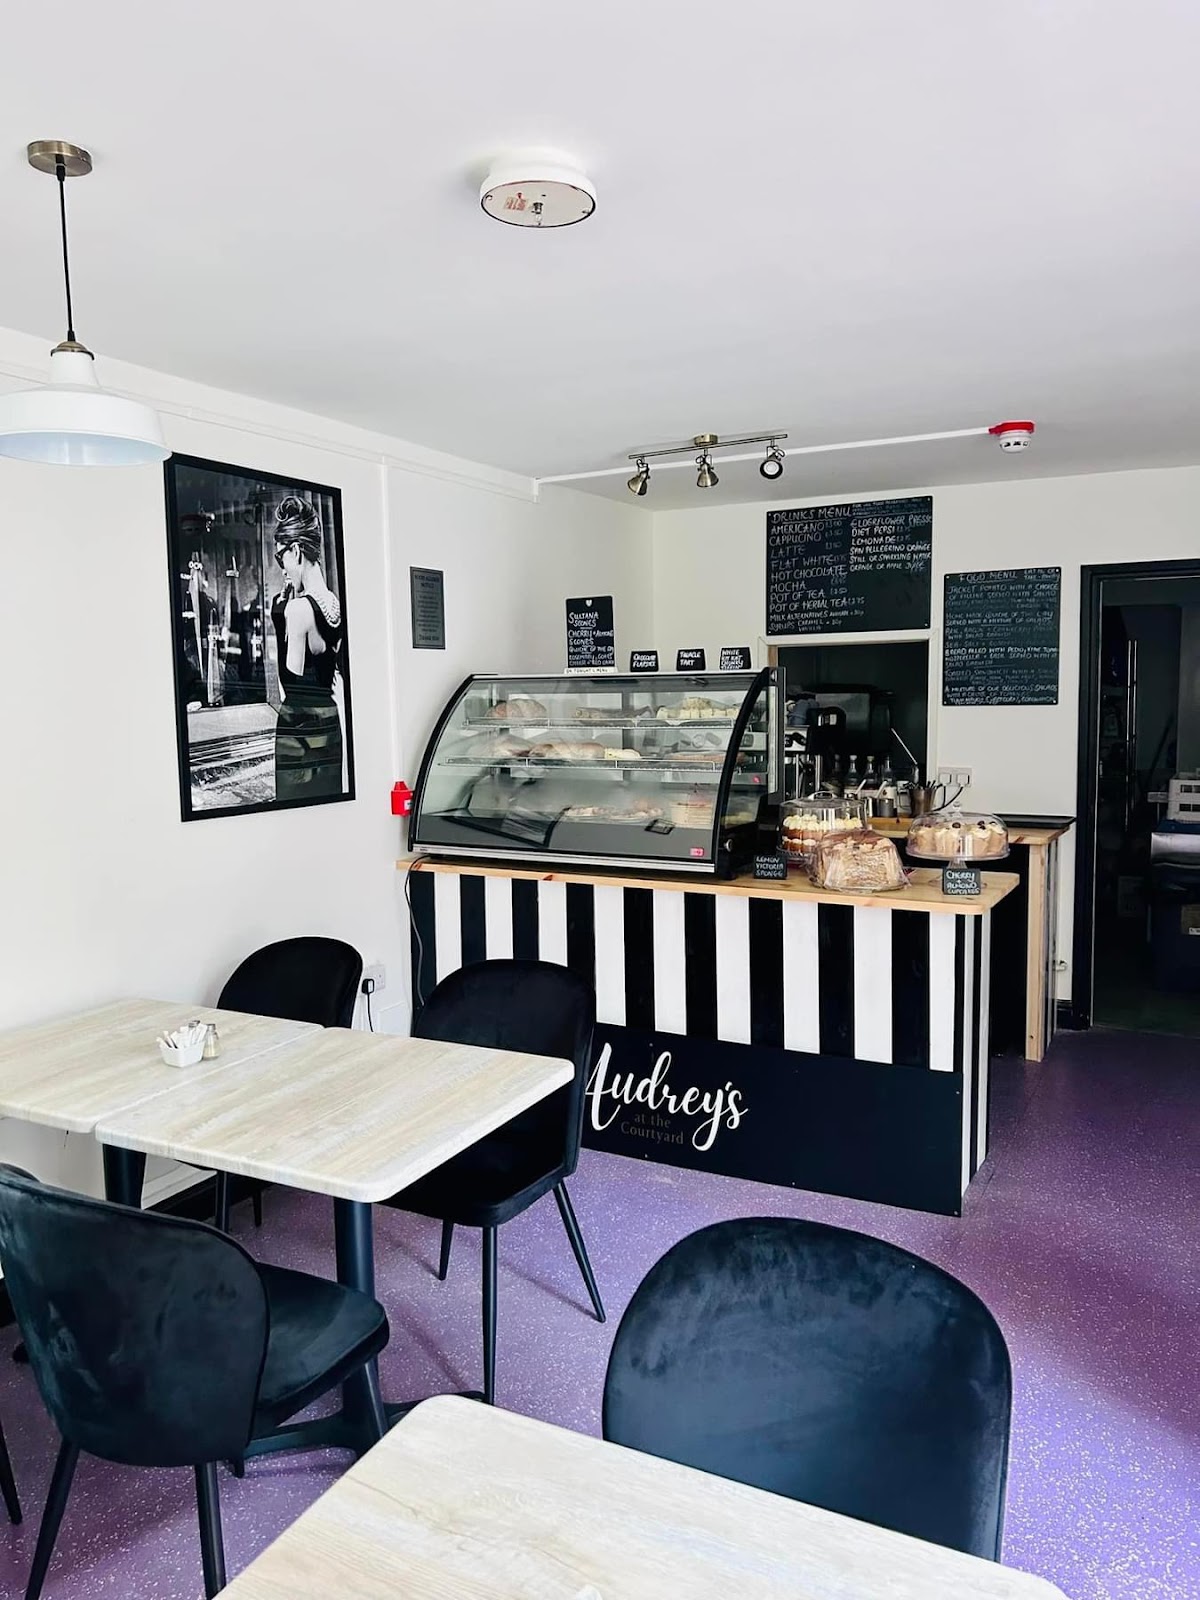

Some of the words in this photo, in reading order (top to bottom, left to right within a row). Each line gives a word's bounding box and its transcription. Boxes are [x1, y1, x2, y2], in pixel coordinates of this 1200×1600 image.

[771, 509, 815, 524] DRINKS
[818, 506, 852, 519] MENU
[771, 522, 825, 535] AMERICANO
[850, 515, 905, 529] ELDERFLOWER
[852, 526, 872, 537] DIET
[873, 525, 896, 535] PEPSI
[771, 545, 806, 559] LATTE
[850, 546, 864, 556] SAN
[771, 558, 799, 571] FLAT
[803, 554, 834, 566] WHITE
[849, 555, 866, 564] STILL
[772, 570, 793, 582] HOT
[793, 564, 848, 580] CHOCOLATE
[959, 572, 986, 583] FOOD
[989, 570, 1018, 580] MENU
[770, 581, 807, 593] MOCHA
[946, 584, 978, 595] JACKET
[1034, 581, 1060, 590] CHOICE
[770, 591, 790, 603] POT
[791, 590, 806, 601] OF
[806, 588, 826, 600] TEA
[769, 602, 788, 613] POT
[788, 602, 802, 612] OF
[829, 597, 847, 608] TEA
[568, 611, 599, 624] SULTANA
[573, 619, 597, 628] SCONES
[769, 613, 786, 621] MILK
[568, 629, 593, 640] CHERRY
[568, 638, 595, 646] SCONES
[680, 659, 695, 667] TART
[755, 862, 784, 871] VICTORIA
[755, 870, 784, 878] SPONGE
[585, 1042, 749, 1152] Audrey's
[634, 1112, 646, 1124] at
[648, 1112, 672, 1129] the
[620, 1120, 685, 1146] Courtyard
